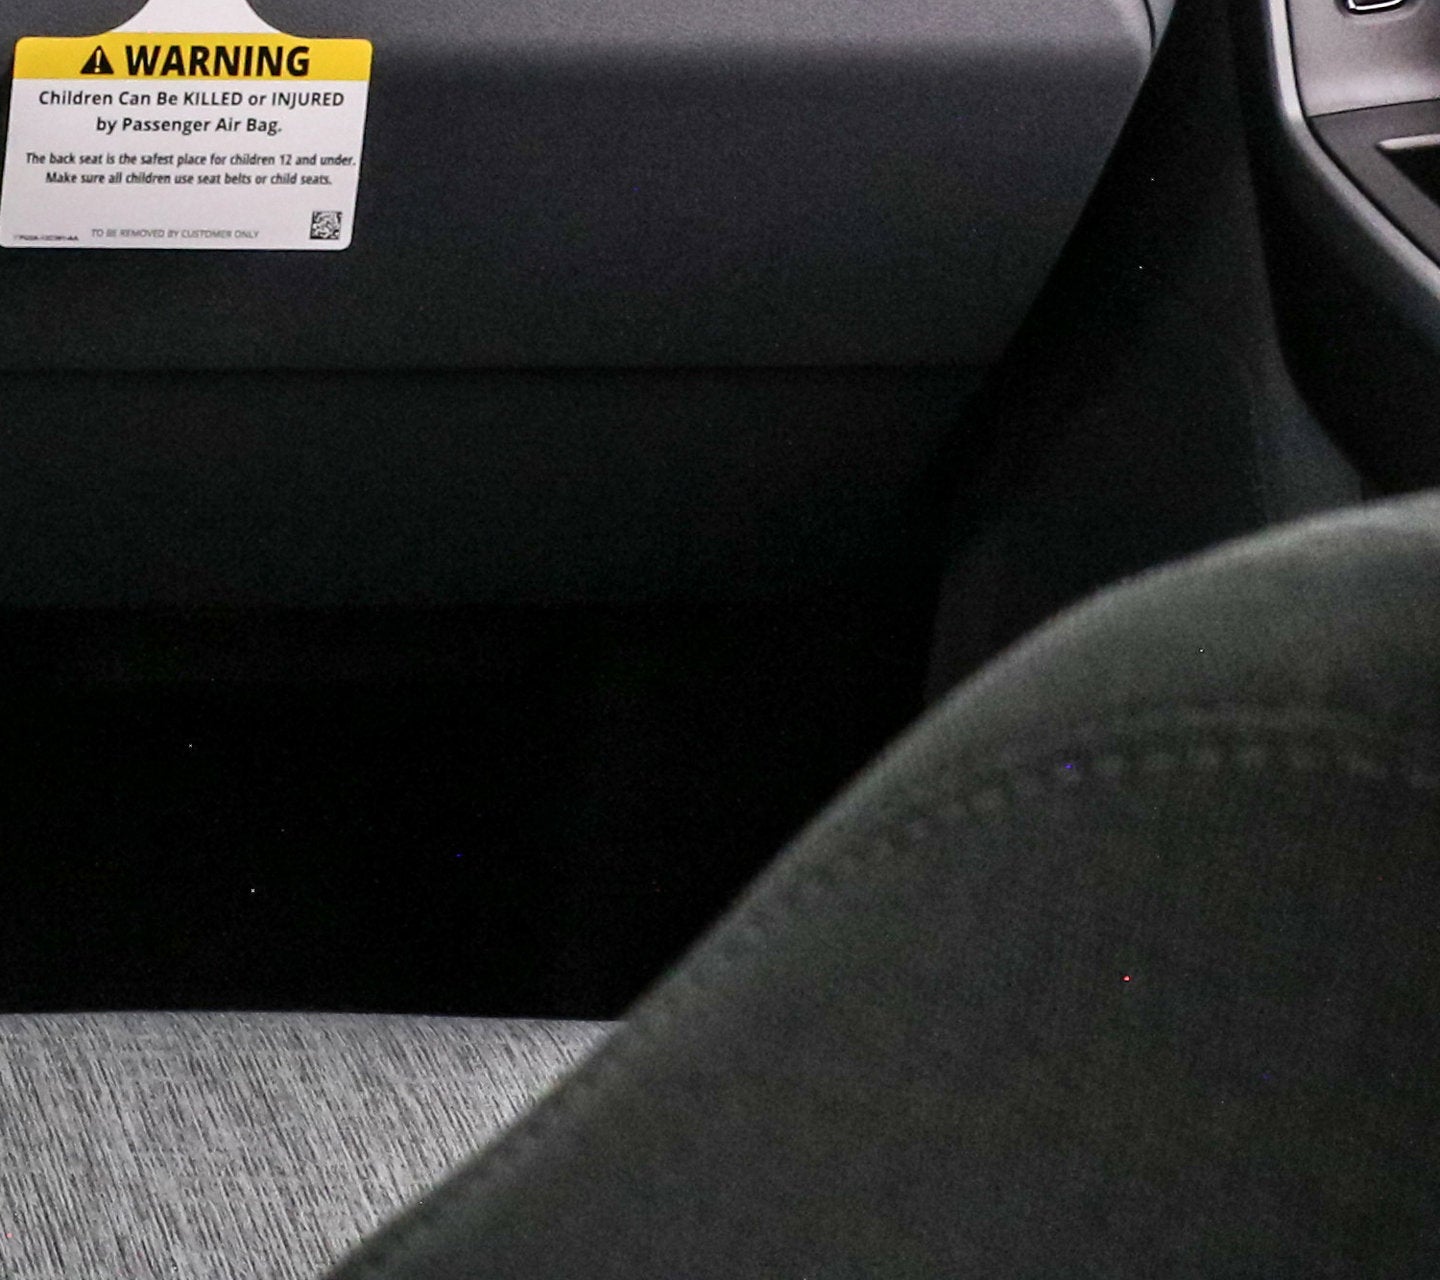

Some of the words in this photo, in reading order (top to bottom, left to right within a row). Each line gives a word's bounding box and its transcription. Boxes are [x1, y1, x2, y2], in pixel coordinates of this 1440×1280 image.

[125, 45, 310, 77] WARNING
[39, 90, 113, 106] Children
[118, 91, 150, 106] Can
[157, 91, 178, 106] Be
[183, 92, 243, 107] KILLED
[248, 95, 266, 107] or
[271, 92, 344, 110] INJURED
[96, 117, 117, 134] by
[122, 118, 211, 135] Passenger
[215, 118, 241, 132] Air
[246, 118, 283, 136] Bag.
[26, 152, 46, 164] The
[49, 152, 75, 164] back
[80, 154, 102, 165] seat
[106, 153, 115, 164] is
[119, 153, 137, 165] the
[141, 152, 173, 165] safest
[177, 153, 207, 168] place
[210, 154, 226, 165] for
[230, 153, 275, 166] children
[279, 154, 292, 165] 12
[295, 154, 316, 166] and
[320, 154, 356, 166] under.
[46, 172, 77, 183] Make
[81, 174, 105, 183] sure
[108, 172, 122, 184] all
[125, 172, 171, 184] children
[174, 175, 194, 184] use
[197, 174, 220, 184] seat
[224, 173, 251, 184] belts
[255, 175, 266, 184] or
[270, 173, 297, 184] child
[300, 174, 332, 185] seats.
[91, 228, 103, 237] TO
[106, 228, 116, 237] BE
[120, 228, 164, 238] REMOVED
[167, 229, 178, 238] BY
[181, 229, 232, 239] CUSTOMER
[234, 230, 259, 239] ONLY
